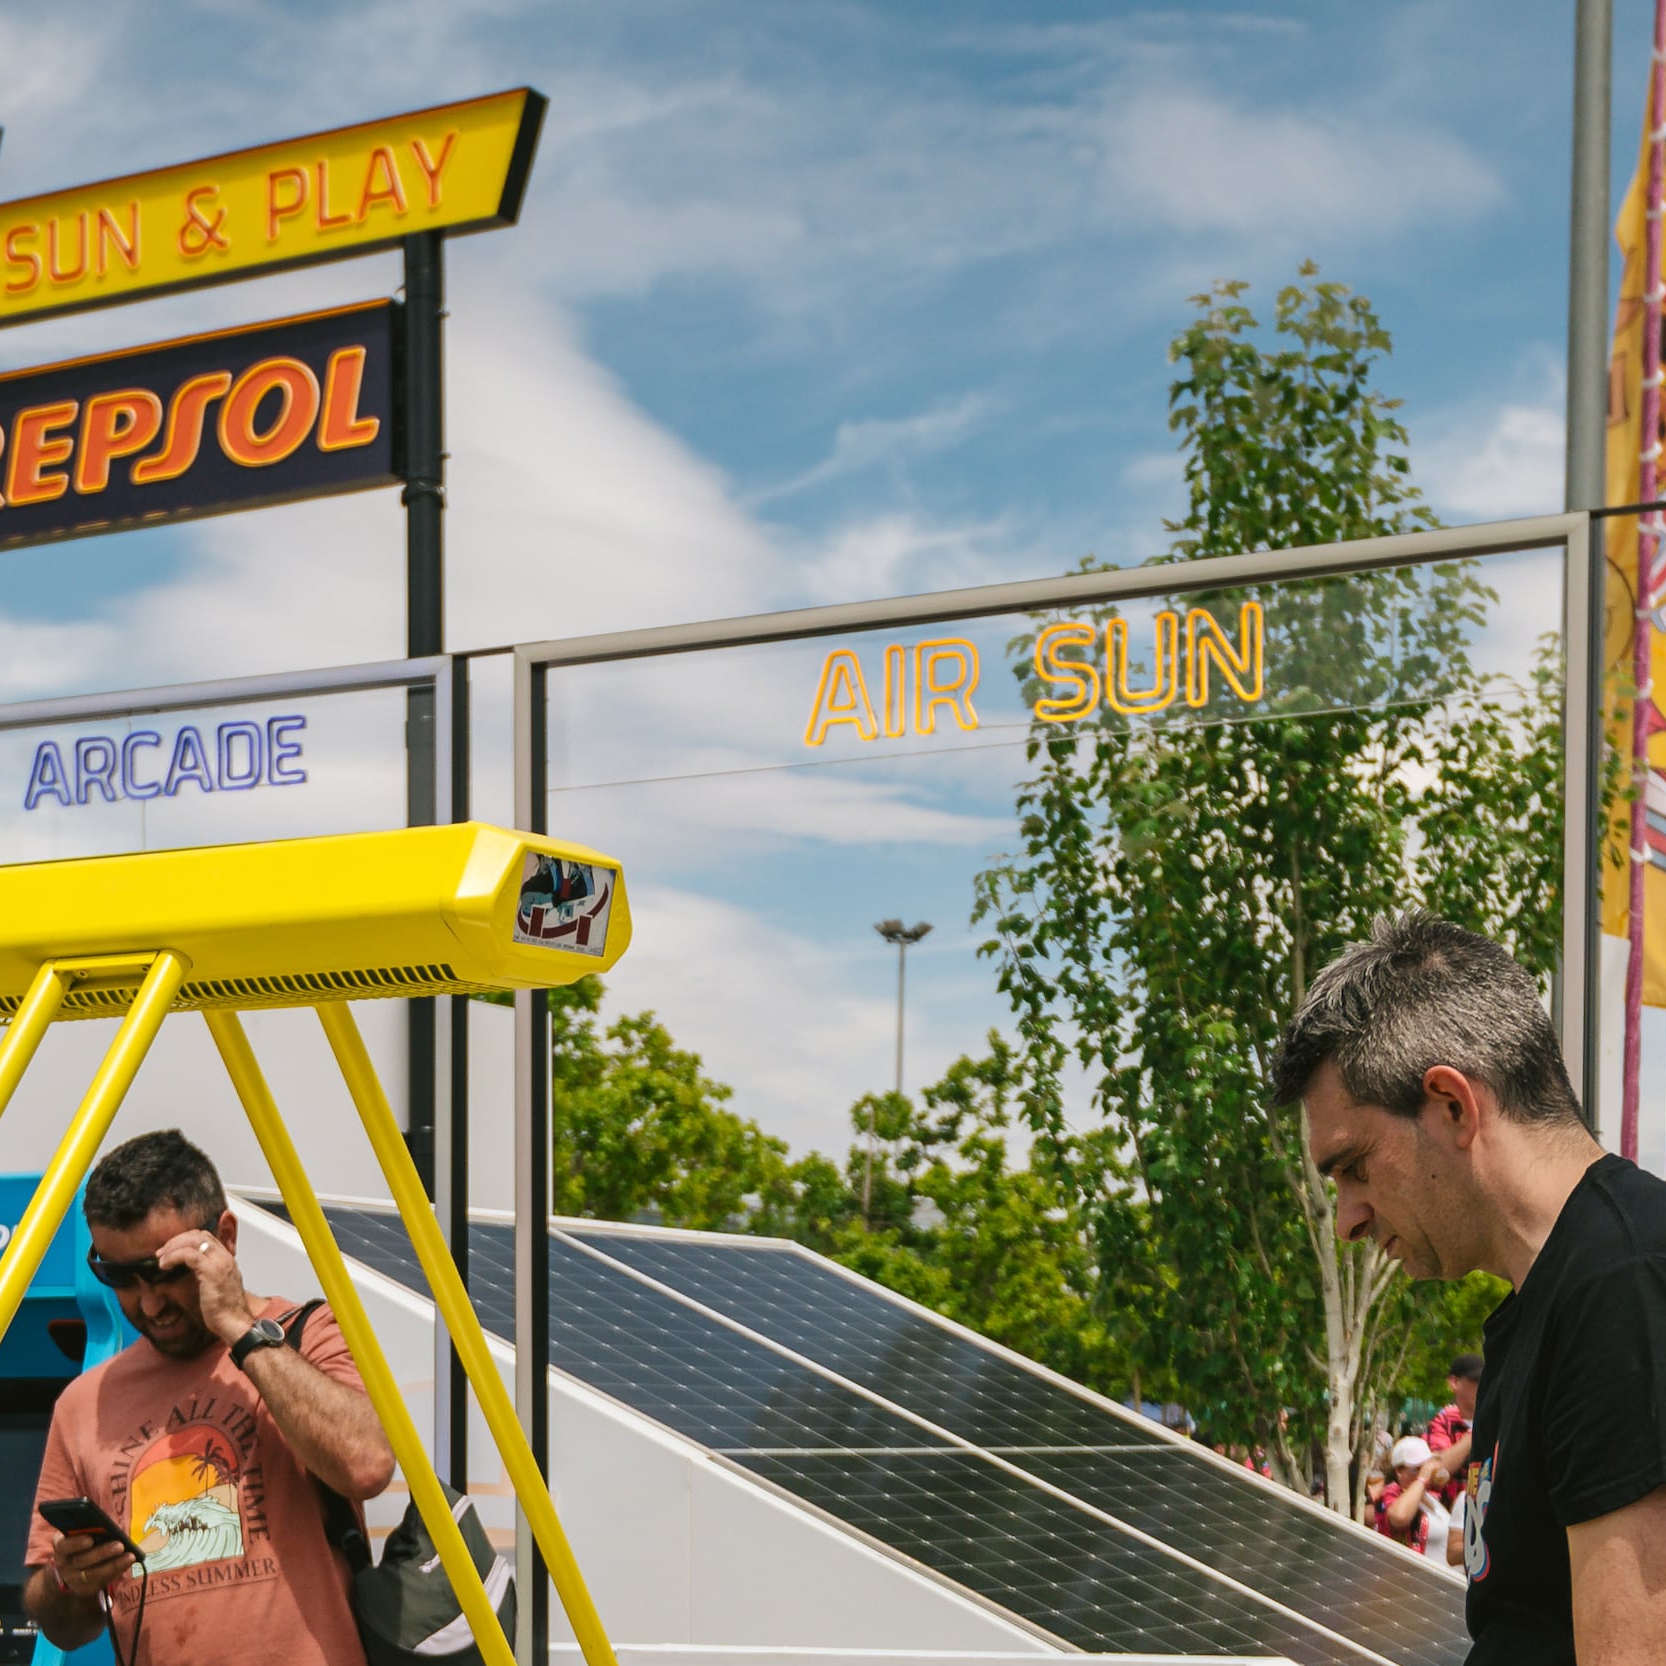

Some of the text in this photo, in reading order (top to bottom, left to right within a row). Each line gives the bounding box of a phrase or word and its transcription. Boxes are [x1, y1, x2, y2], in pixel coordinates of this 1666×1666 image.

[4, 131, 457, 295] SUN & PLAY
[805, 602, 1264, 747] AIR SUN
[23, 714, 308, 811] ARCADE
[109, 1397, 272, 1545] SHINE ALL THE TIME
[120, 1556, 277, 1611] NDLESS SUMMER
